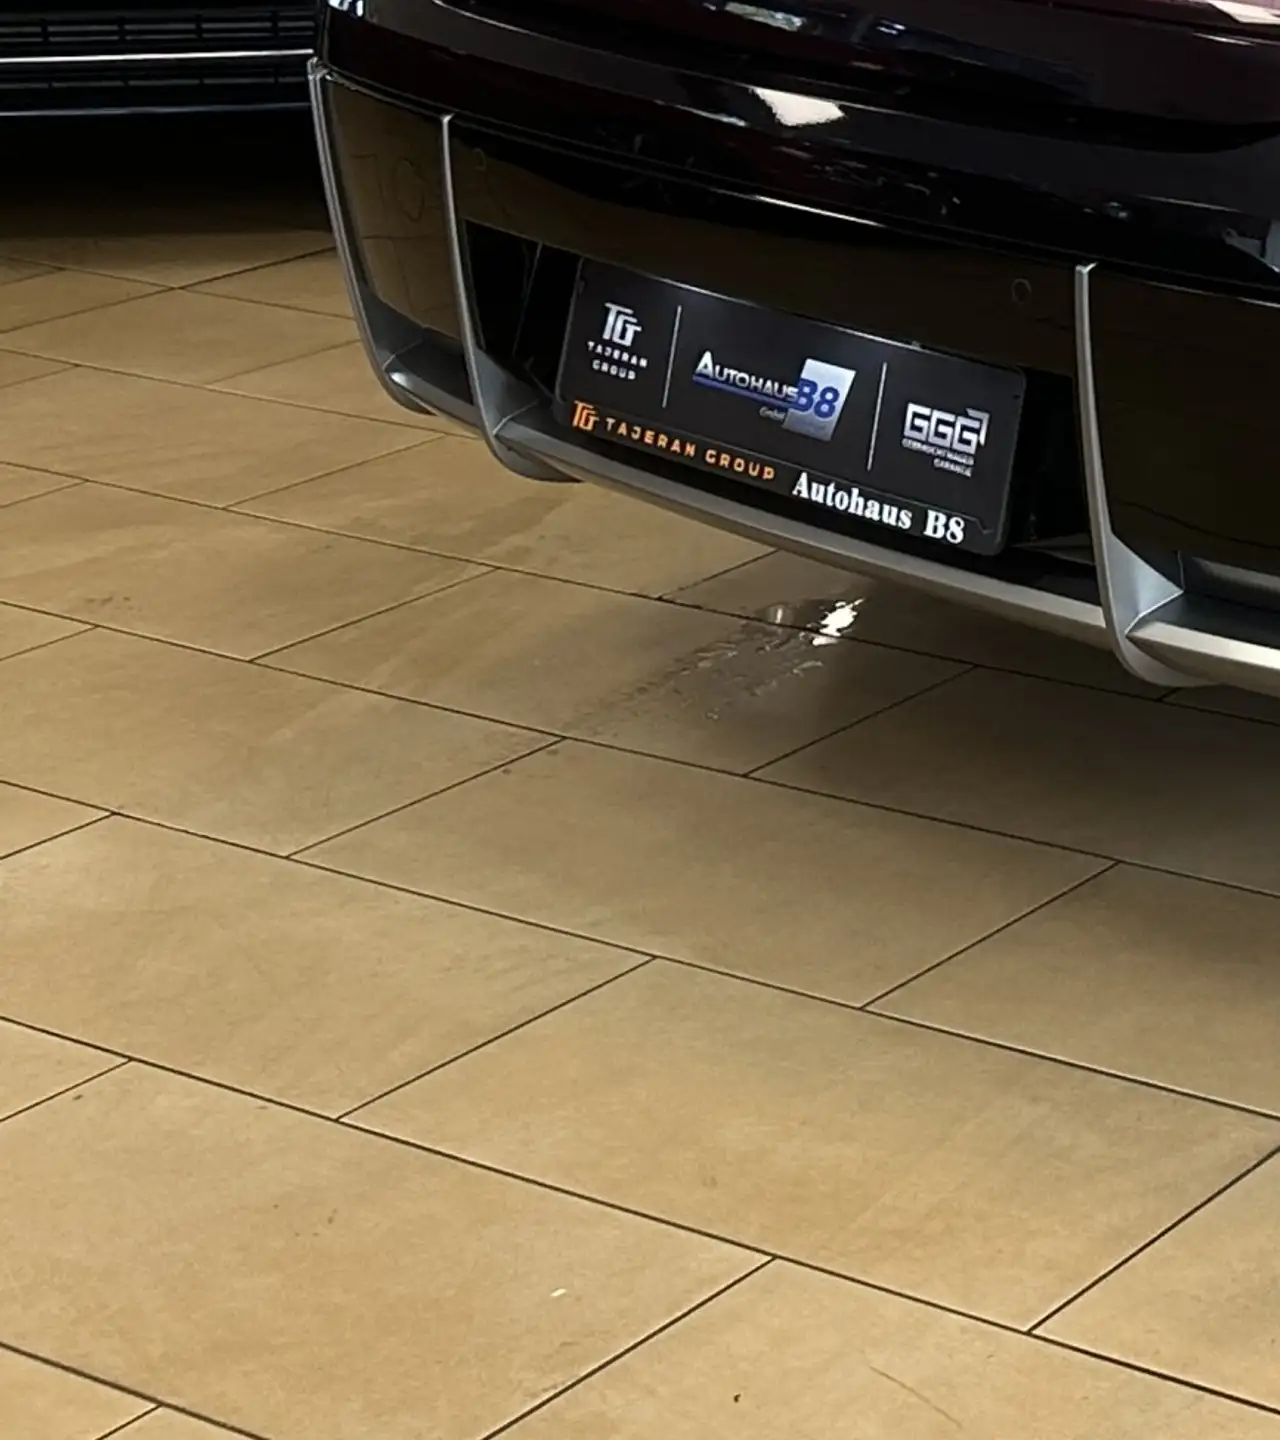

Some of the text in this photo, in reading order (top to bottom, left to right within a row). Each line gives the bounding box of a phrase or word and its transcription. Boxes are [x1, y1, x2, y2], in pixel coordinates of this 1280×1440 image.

[587, 340, 648, 368] TAJERAN
[592, 359, 637, 381] GROUP
[605, 417, 696, 458] TAJERAN
[705, 448, 776, 481] GROUP
[791, 471, 913, 530] Autohaus
[923, 509, 966, 545] B8
